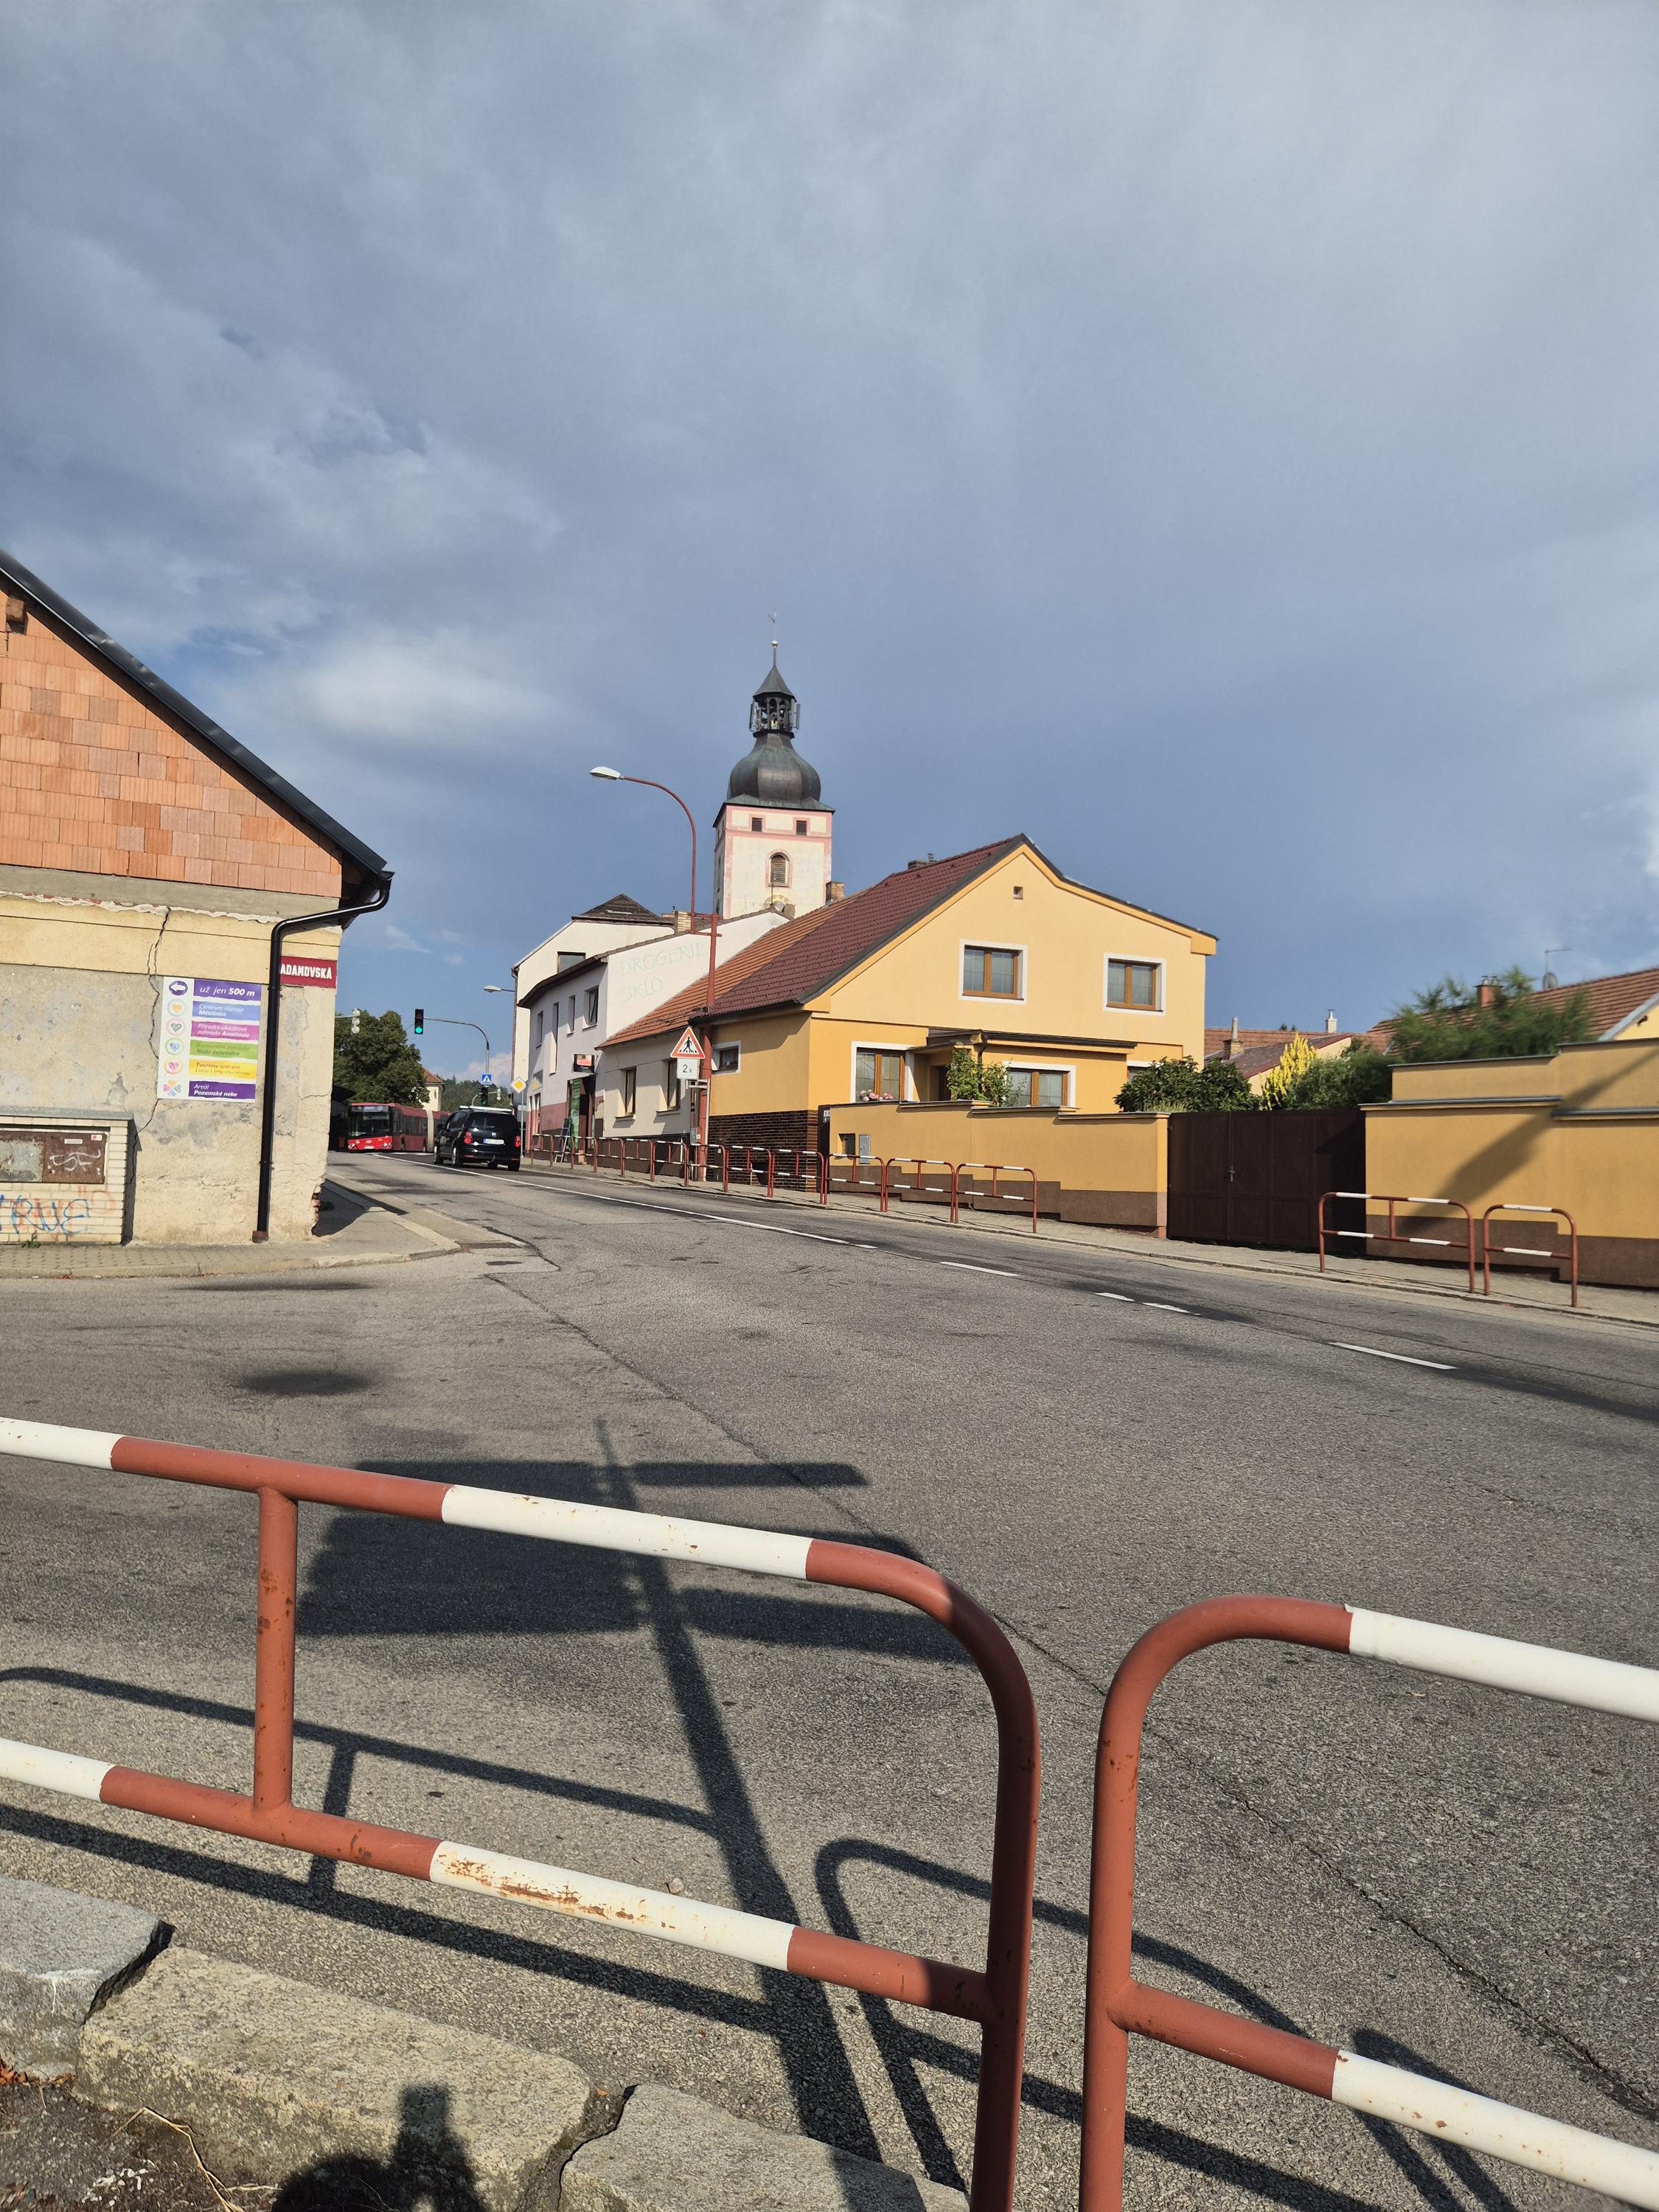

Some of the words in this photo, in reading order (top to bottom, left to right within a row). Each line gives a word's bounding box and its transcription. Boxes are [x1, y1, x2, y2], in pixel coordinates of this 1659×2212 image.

[619, 942, 709, 975] DROGERIE
[213, 987, 226, 995] jen
[228, 987, 245, 996] 500
[619, 976, 664, 1003] SKLO
[683, 1064, 688, 1074] 2
